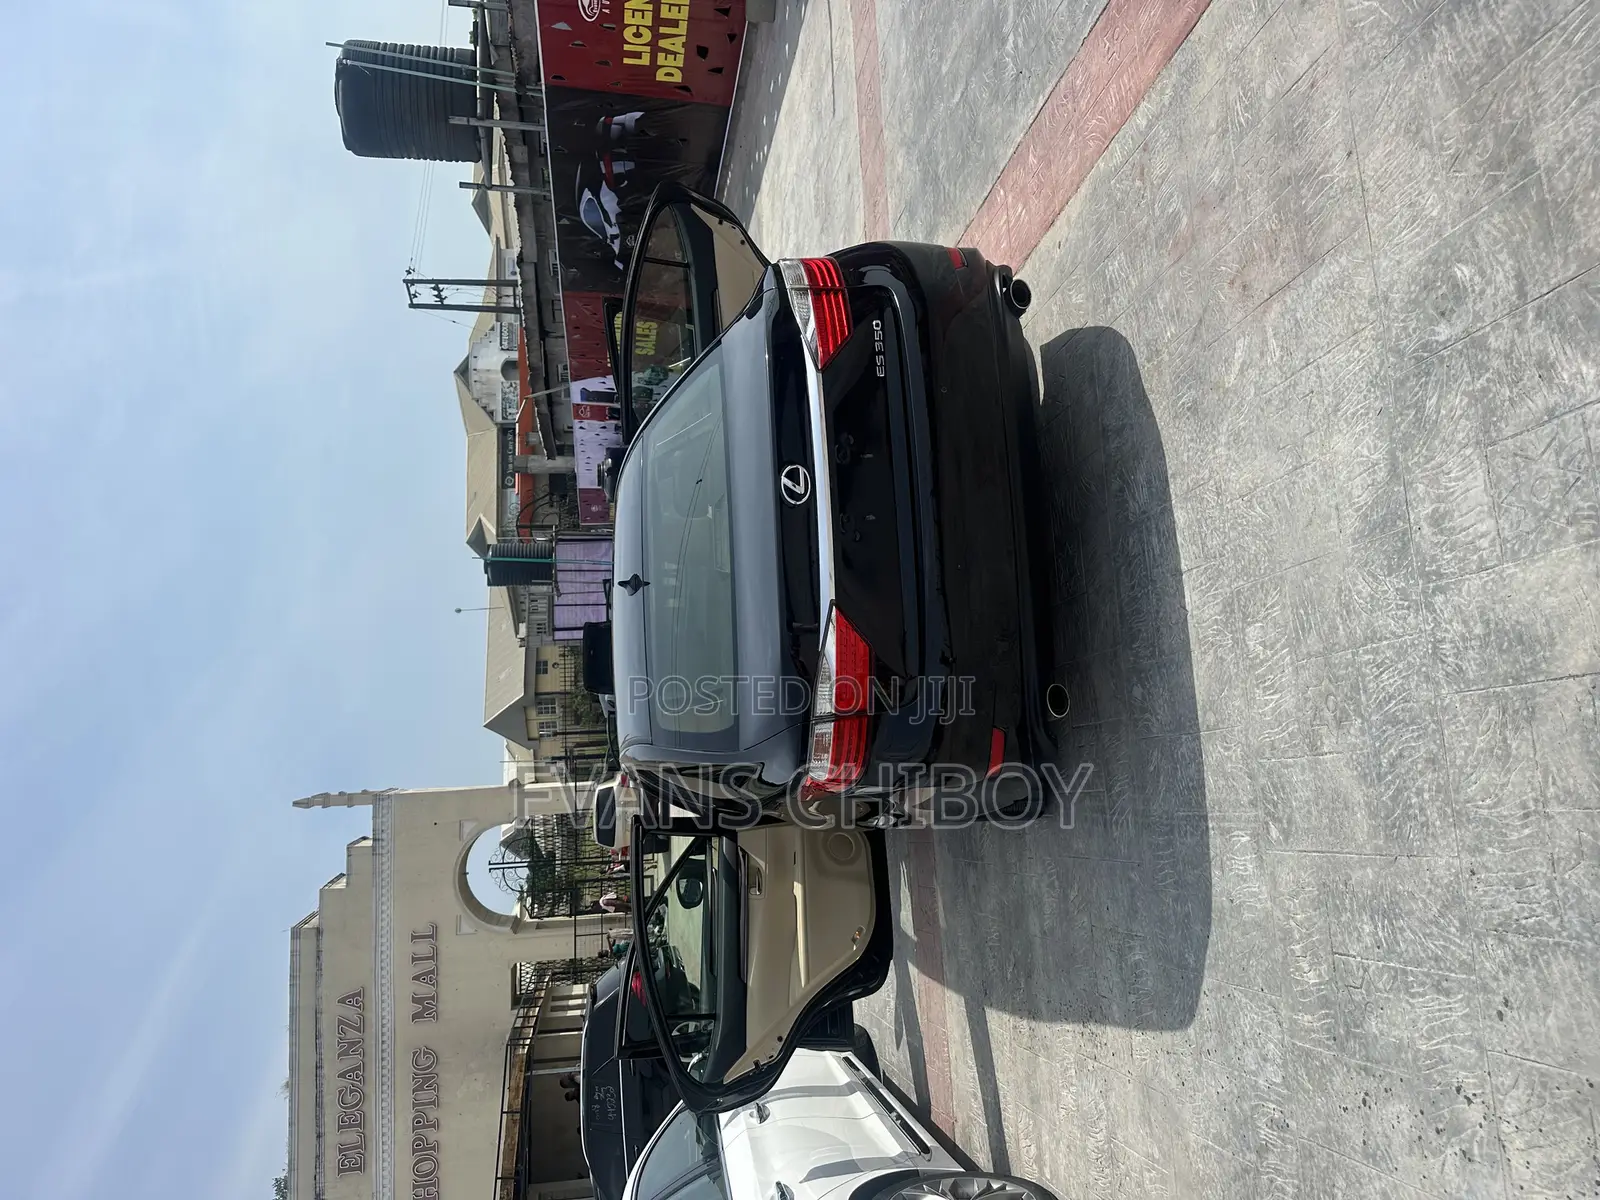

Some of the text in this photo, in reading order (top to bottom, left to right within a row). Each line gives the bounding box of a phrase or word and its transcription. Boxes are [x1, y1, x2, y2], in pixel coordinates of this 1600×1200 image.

[656, 0, 688, 82] DEALE
[634, 321, 658, 356] SALES
[872, 320, 885, 377] ES 350
[410, 922, 438, 1024] MALL
[336, 986, 366, 1178] ELEGANZA
